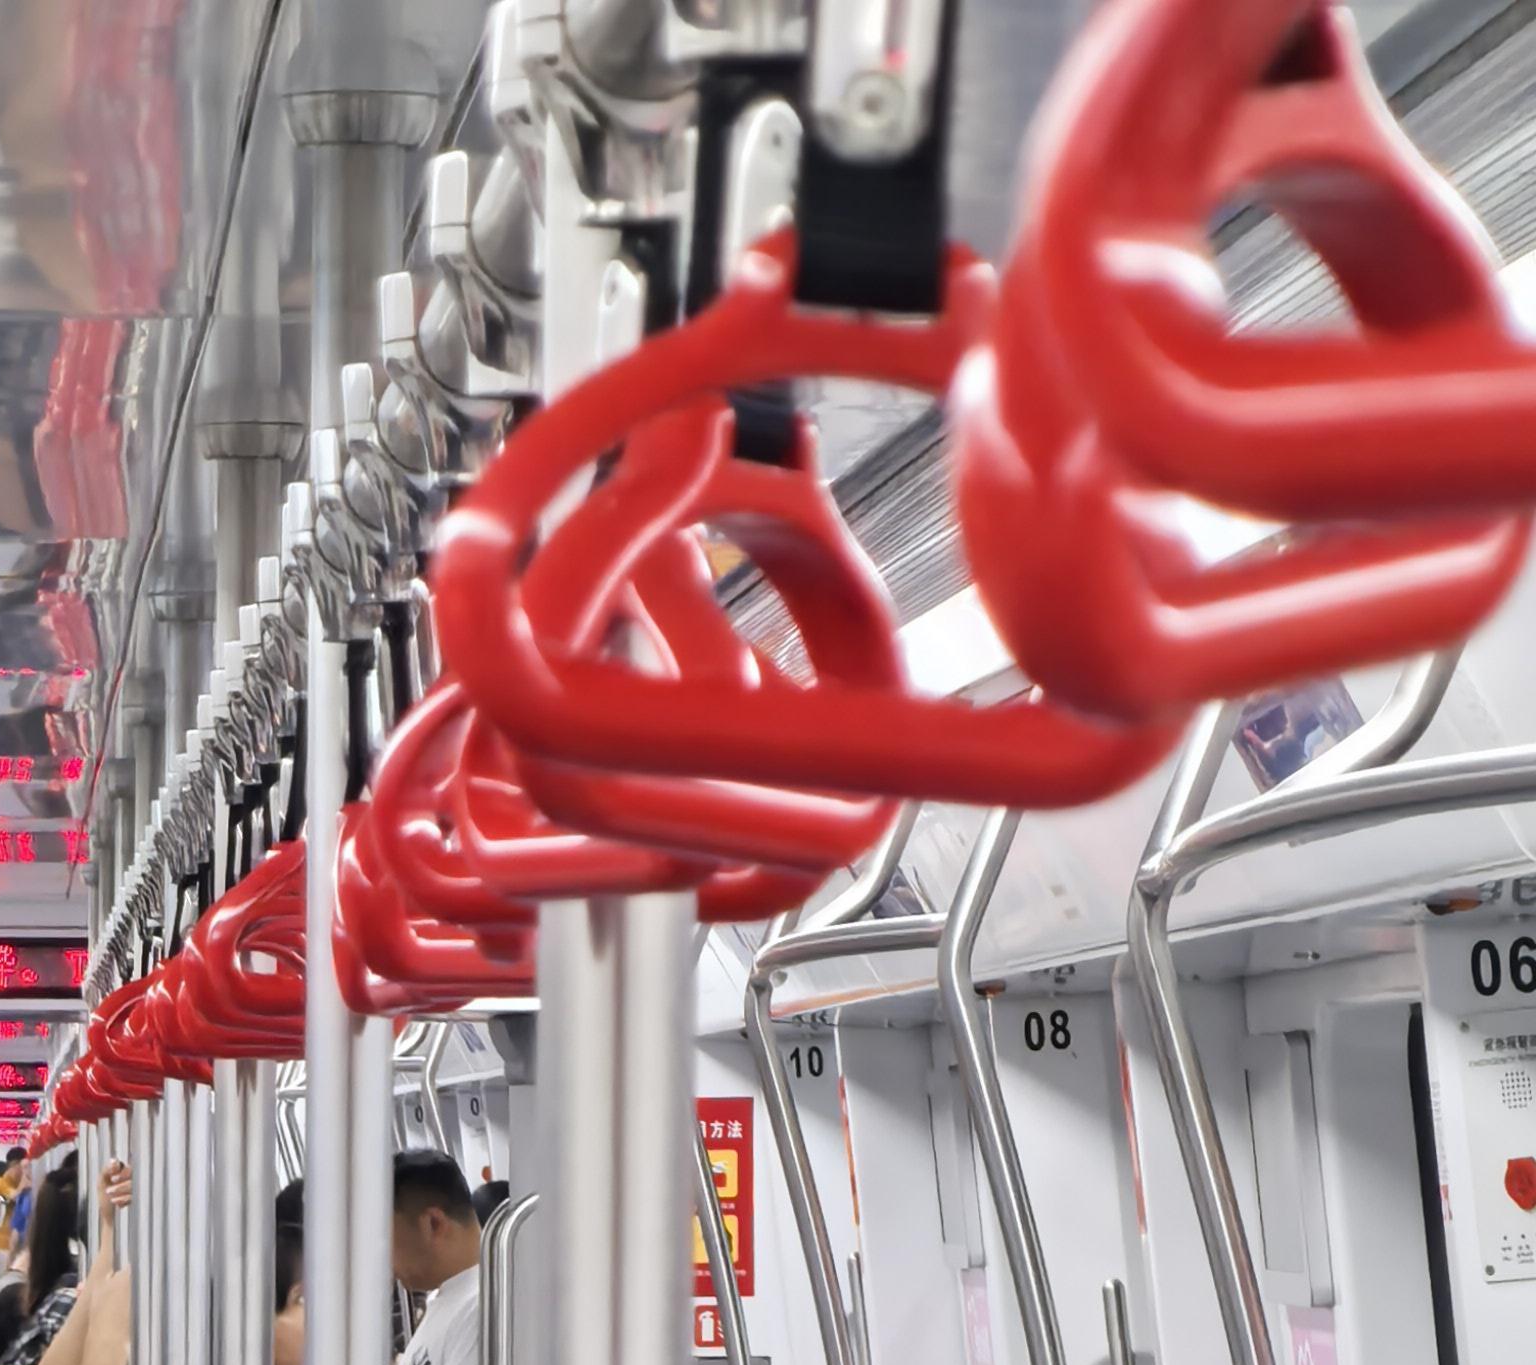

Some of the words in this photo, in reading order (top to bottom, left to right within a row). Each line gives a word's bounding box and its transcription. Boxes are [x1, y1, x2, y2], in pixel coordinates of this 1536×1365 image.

[1470, 936, 1536, 997] 06
[1024, 1009, 1071, 1051] 08
[789, 1046, 824, 1078] 10
[700, 1119, 744, 1139] 方法
